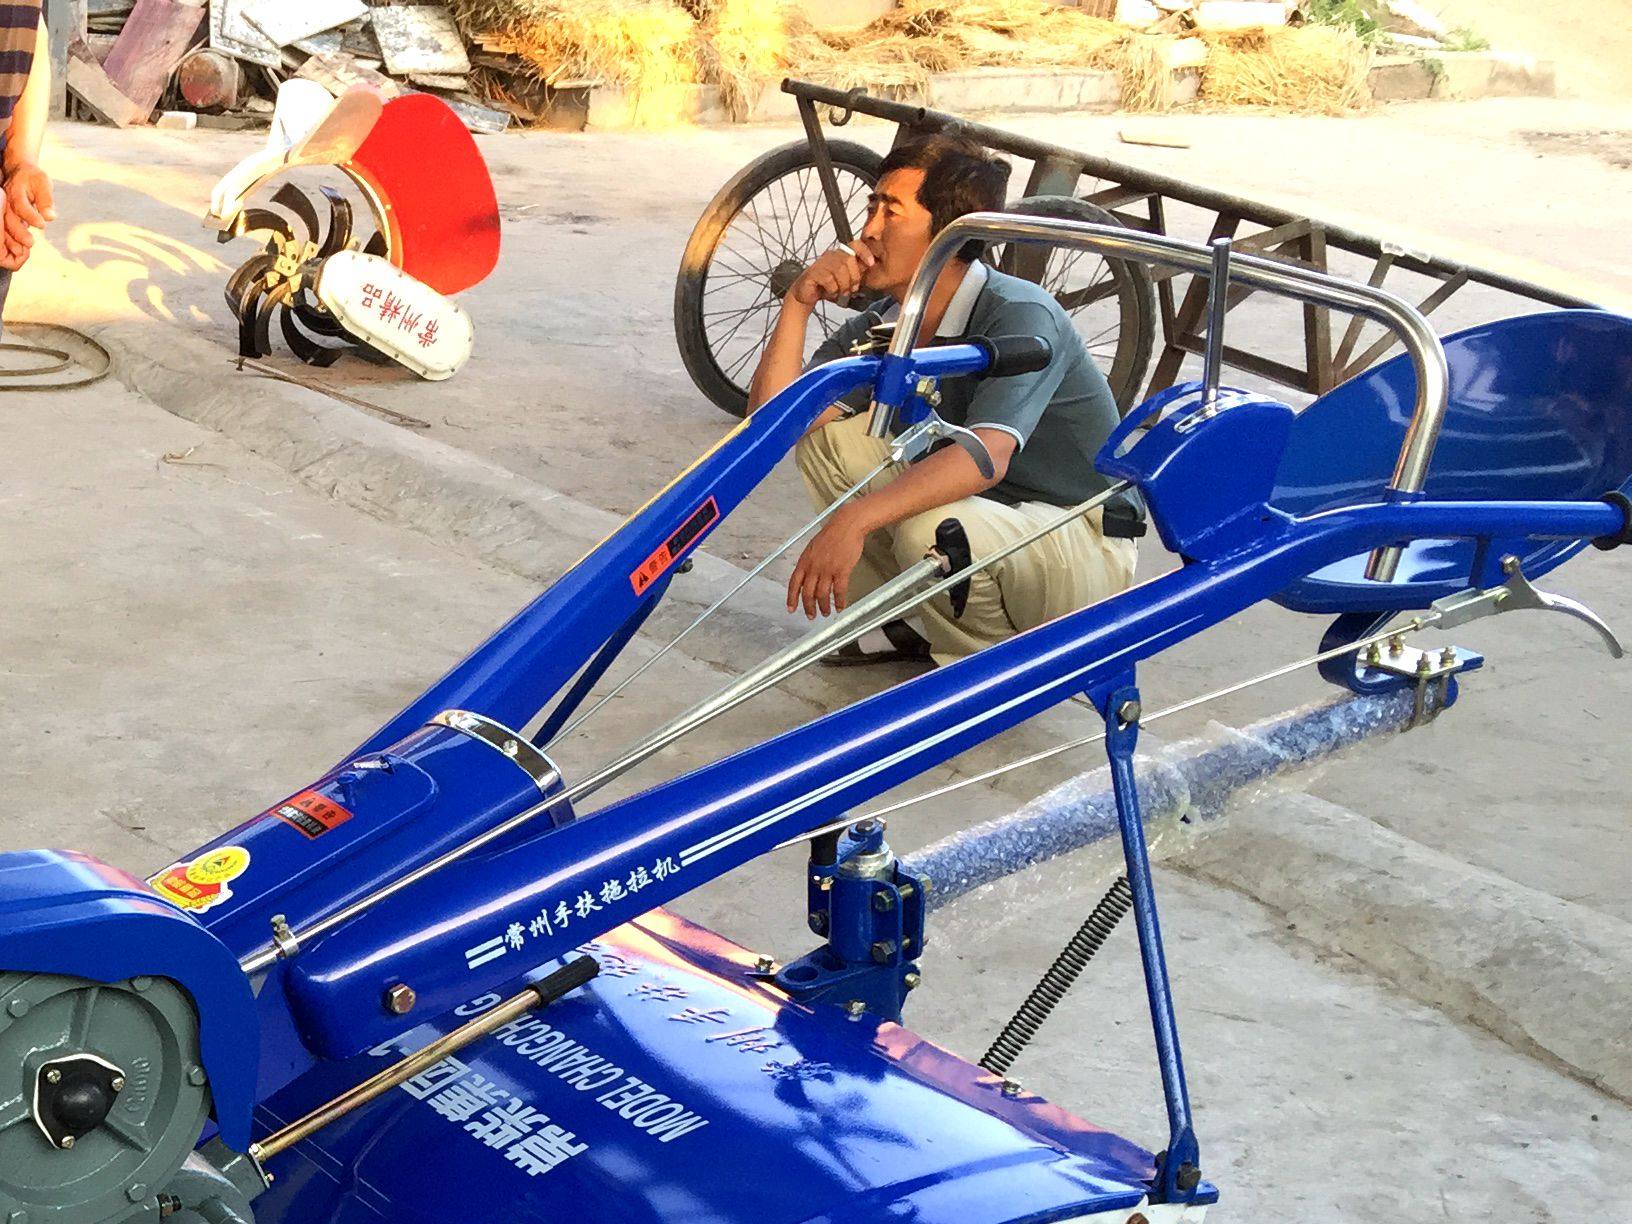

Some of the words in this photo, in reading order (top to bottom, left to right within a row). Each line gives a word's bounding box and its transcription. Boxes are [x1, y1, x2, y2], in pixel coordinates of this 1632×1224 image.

[362, 283, 439, 348] 常州精品
[504, 856, 680, 951] 常州手扶拖拉机
[607, 1076, 709, 1143] MODEL
